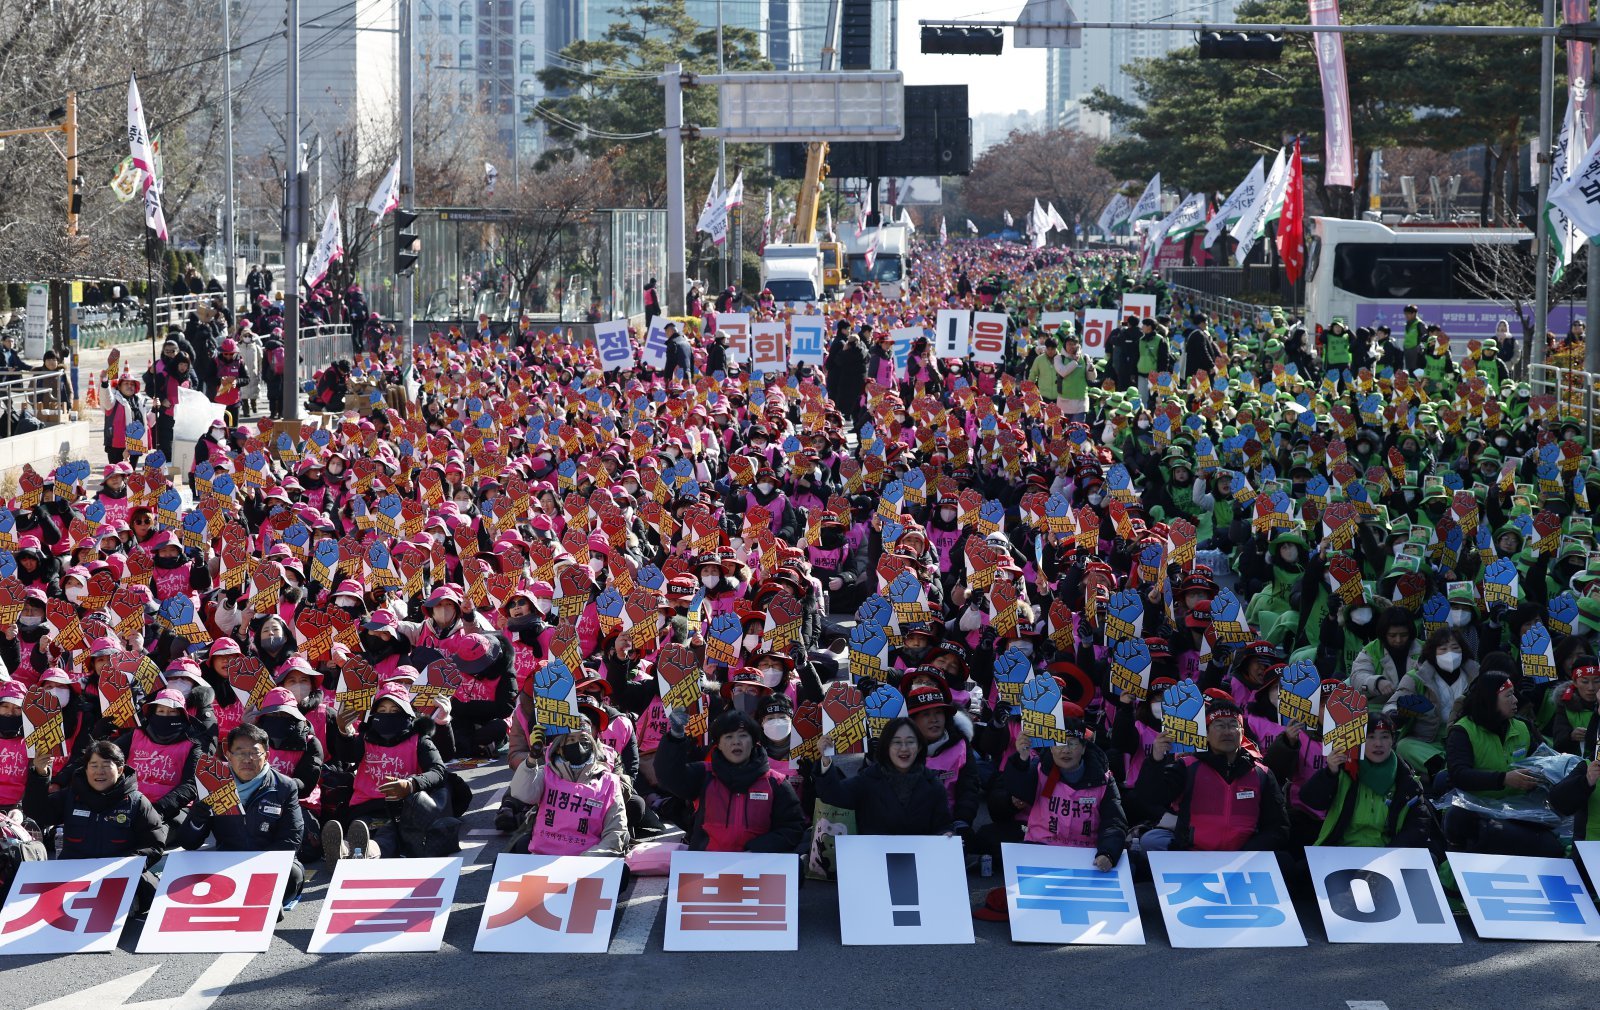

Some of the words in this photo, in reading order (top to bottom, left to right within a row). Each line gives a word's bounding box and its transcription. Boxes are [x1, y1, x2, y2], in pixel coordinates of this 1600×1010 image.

[599, 330, 631, 362] 정
[793, 327, 823, 355] 교
[948, 318, 957, 350] !
[975, 321, 1004, 352] 응
[755, 332, 784, 363] 회
[1484, 583, 1512, 594] 차별을
[1485, 591, 1518, 607] 끝내자!
[893, 602, 923, 612] 차별을
[898, 610, 932, 624] 끝내자!
[1106, 614, 1136, 633] 차별을
[1213, 621, 1242, 632] 차별을
[706, 647, 739, 667] 끝내자!
[707, 636, 735, 654] 차별을
[849, 649, 881, 669] 차별을
[1522, 654, 1548, 667] 차별을
[1522, 662, 1558, 677] 끝내자!
[850, 661, 889, 682] 끝내자!
[1111, 662, 1142, 685] 차별을
[336, 688, 376, 702] 집단임금교섭
[409, 685, 456, 696] 집단임금교섭
[662, 668, 701, 707] 집단임금교섭
[1110, 675, 1147, 700] 끝내자!
[535, 695, 570, 713] 차별을
[1278, 689, 1313, 713] 차별을
[112, 701, 136, 728] 승리!
[537, 709, 581, 728] 끝내자!
[1022, 708, 1057, 728] 차별을
[1162, 714, 1199, 734] 차별을
[1278, 703, 1319, 730] 끝내자!
[25, 711, 63, 749] 집단임금교섭
[834, 724, 867, 754] 승리!
[1023, 726, 1067, 744] 끝내자!
[1323, 713, 1369, 746] 집단임금교섭
[1332, 730, 1367, 753] 승리!
[212, 789, 241, 816] 승리!
[1049, 796, 1092, 818] 비정규직
[677, 872, 788, 932] 별
[885, 853, 921, 927] !
[1015, 865, 1130, 925] 투
[1162, 872, 1286, 929] 쟁
[1323, 868, 1446, 924] 이
[1461, 872, 1587, 925] 답
[2, 877, 129, 934] 저
[158, 872, 279, 933] 임
[326, 877, 446, 934] 금
[487, 875, 613, 934] 차
